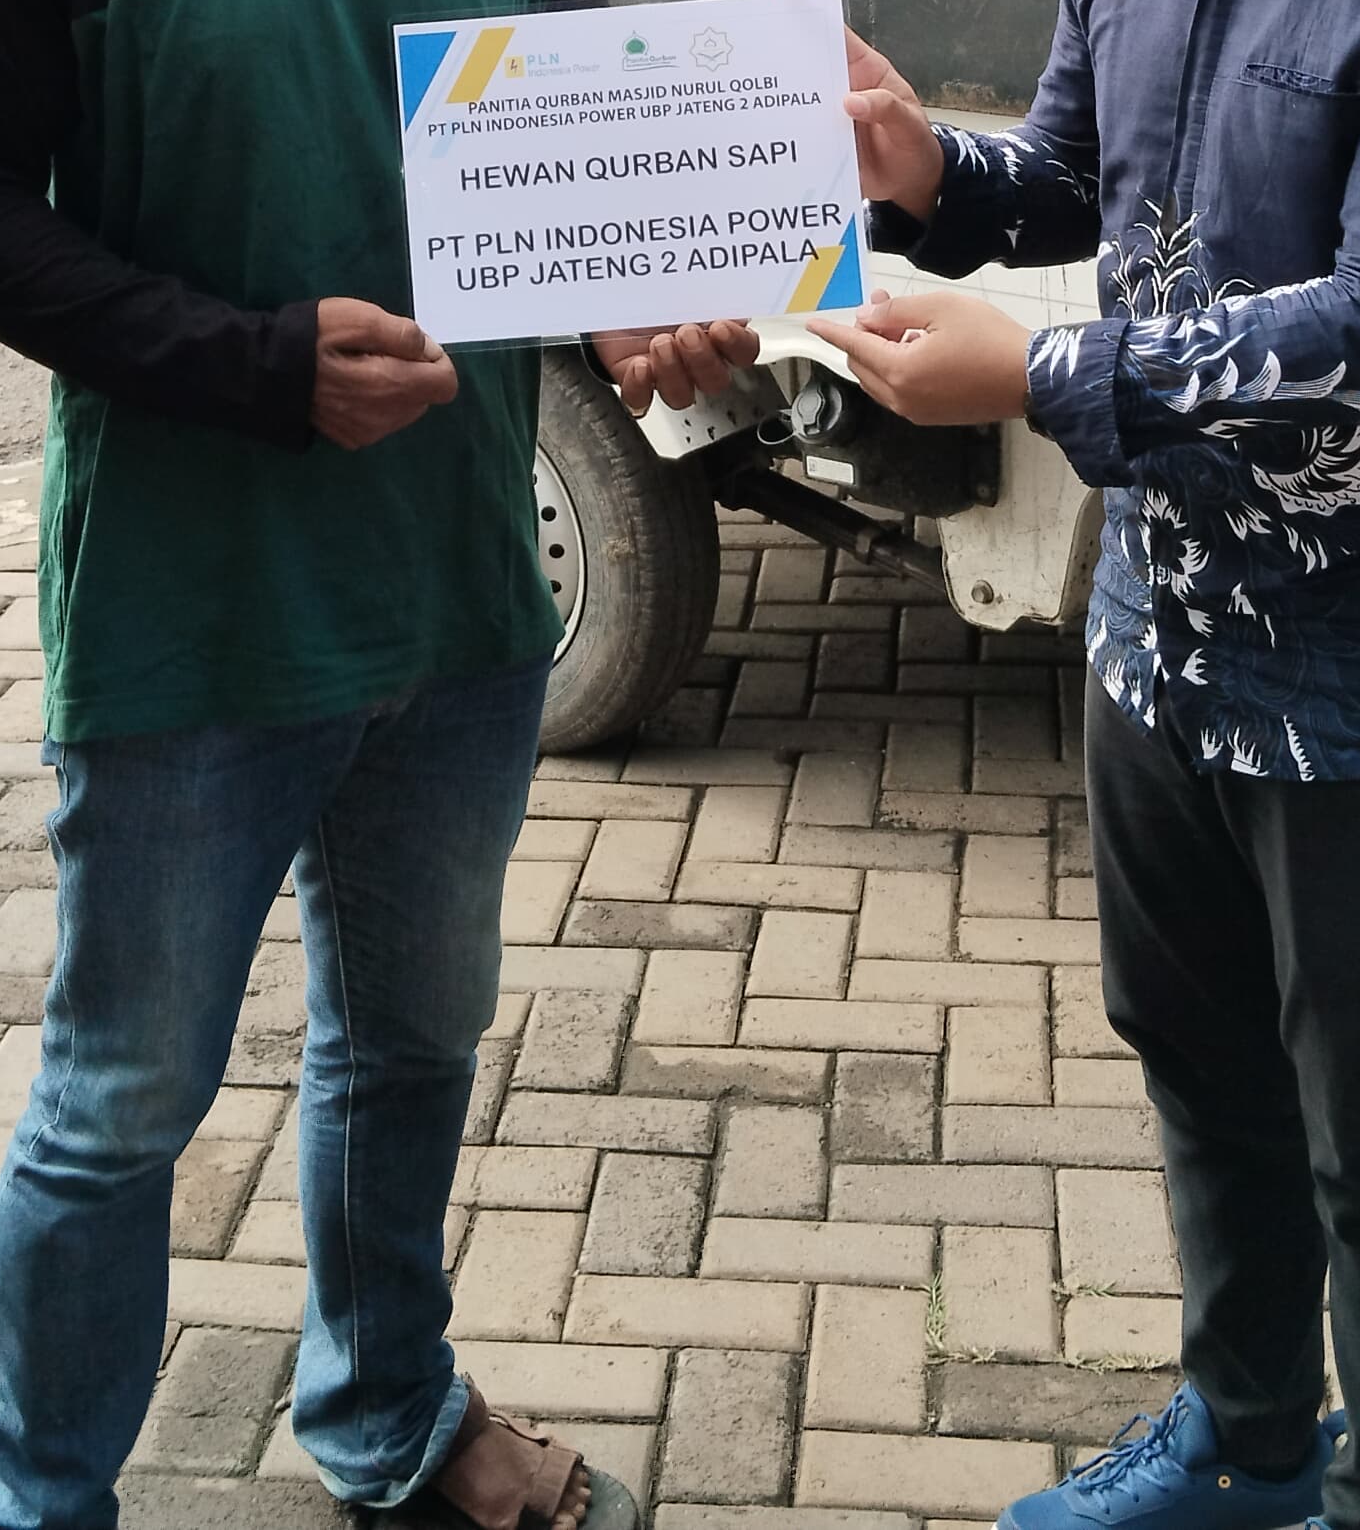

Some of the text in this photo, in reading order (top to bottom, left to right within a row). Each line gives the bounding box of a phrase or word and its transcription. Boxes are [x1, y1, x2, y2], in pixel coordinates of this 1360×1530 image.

[527, 53, 560, 66] PLN
[427, 91, 822, 137] PT PLN INDONESIA POWER UBP JATENG 2 ADIPALA
[468, 76, 779, 115] PANITIA QURBAN MASJID NURUL QOLBI
[460, 139, 797, 192] HEWAN QURBAN SAPI
[427, 202, 842, 261] PT PLN INDONESIA POWER
[456, 238, 820, 291] UBP JATENG 2 ADIPALA
